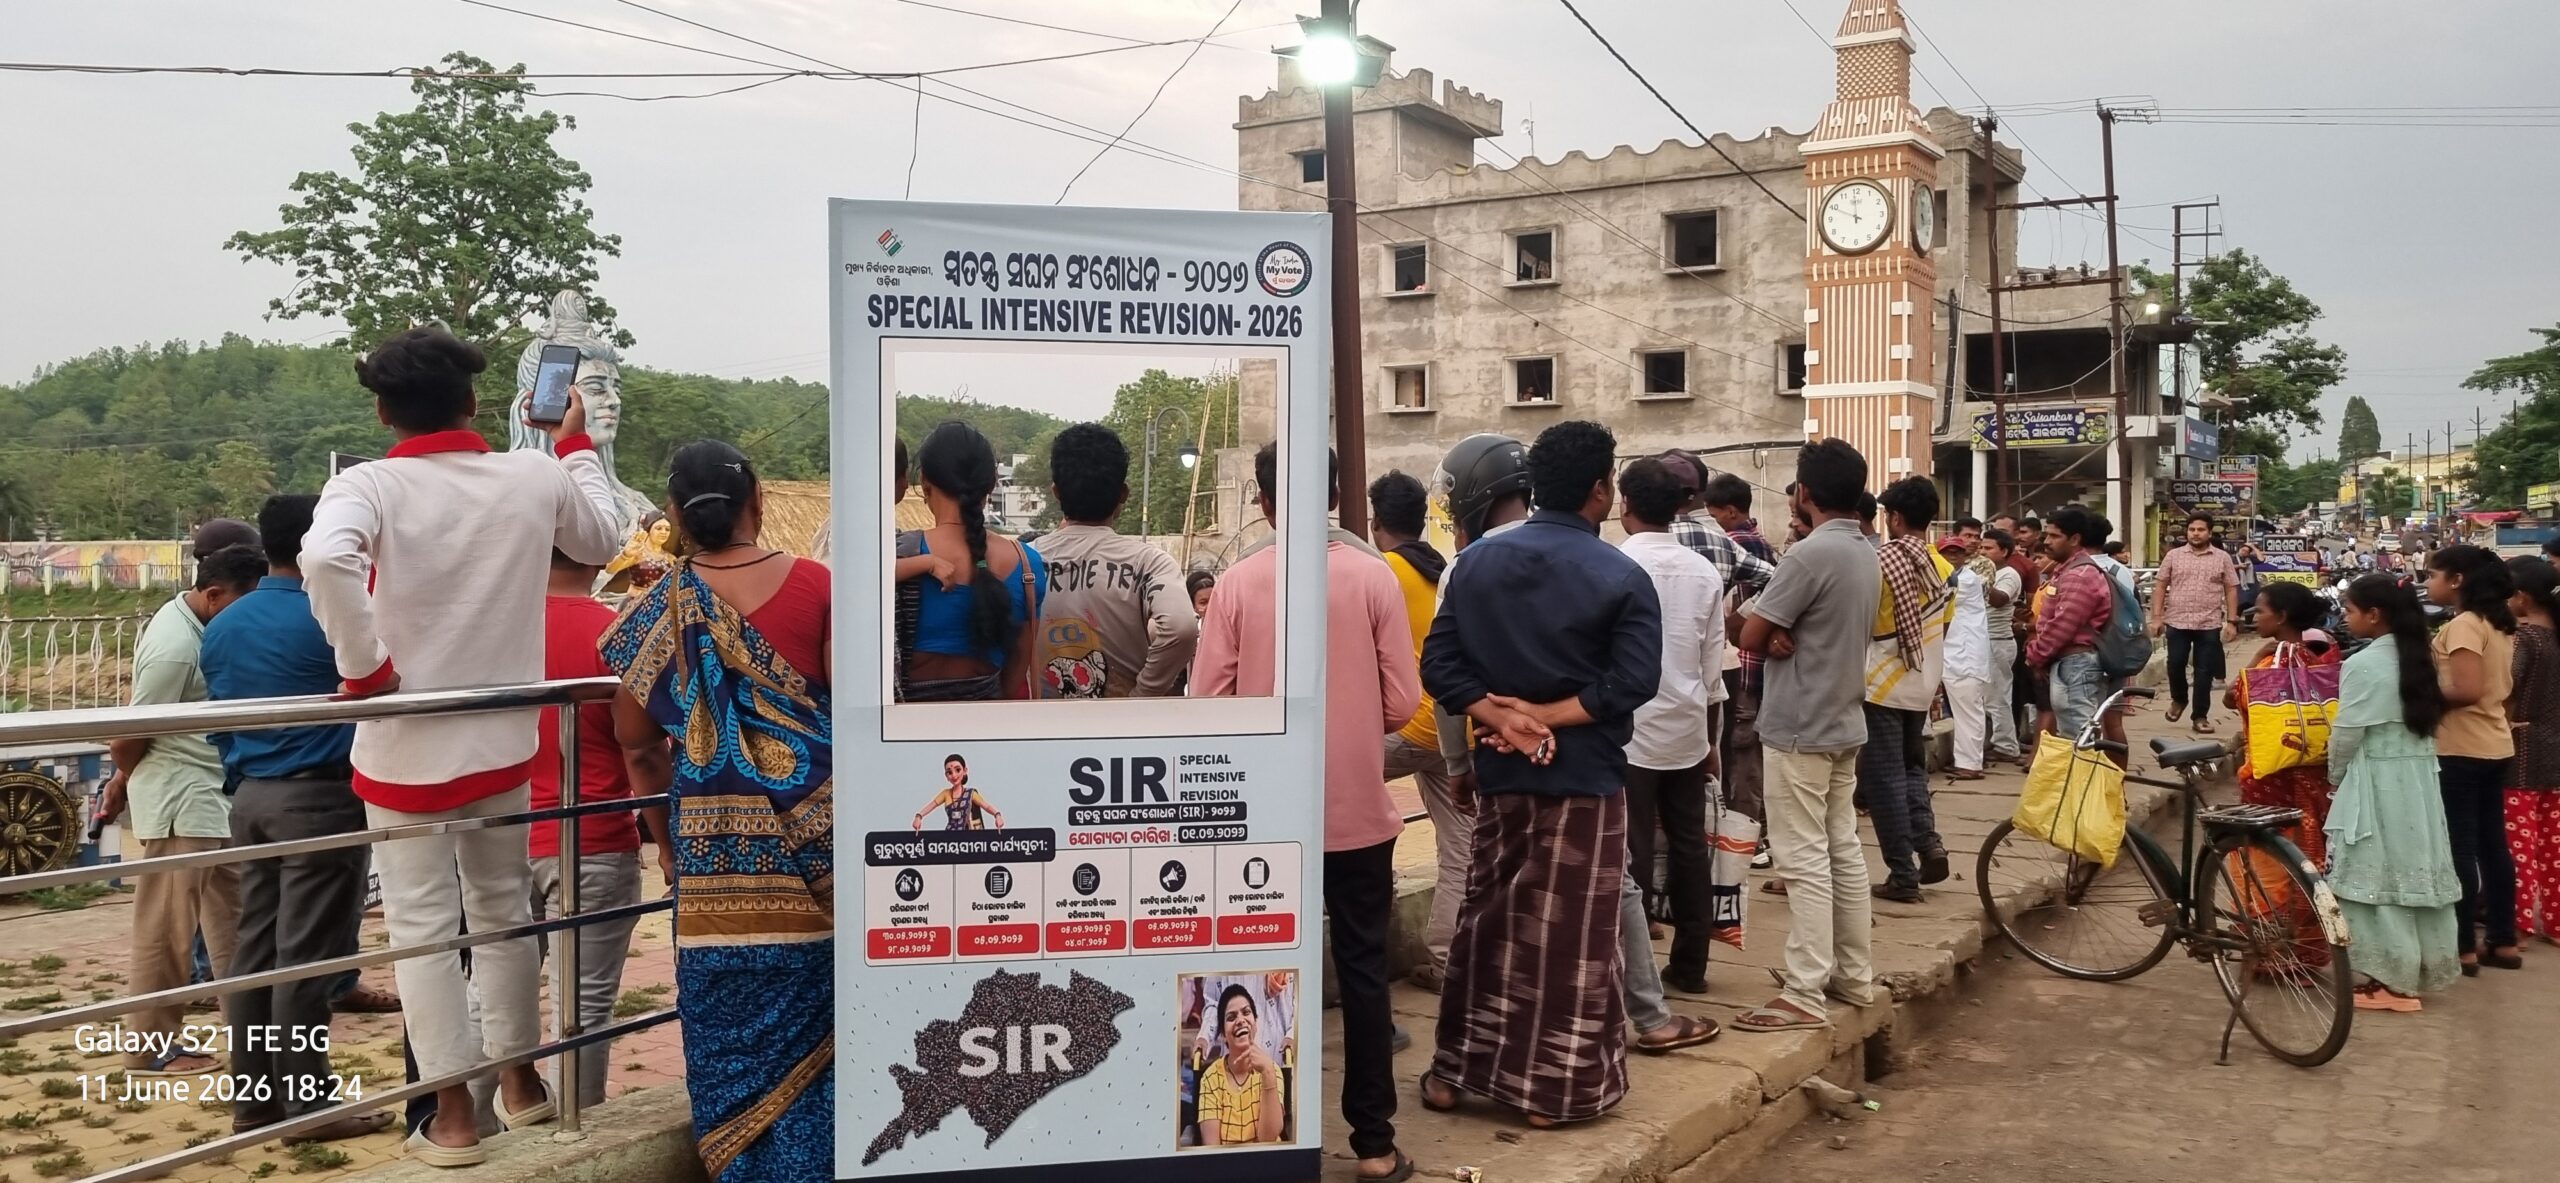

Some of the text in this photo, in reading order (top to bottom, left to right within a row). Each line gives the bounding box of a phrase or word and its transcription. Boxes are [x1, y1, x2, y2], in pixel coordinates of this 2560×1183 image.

[1006, 251, 1059, 290] ସଘନ
[1067, 255, 1161, 292] ସଂଶୋଧନ
[1266, 266, 1303, 275] My Vote
[868, 294, 1304, 338] SPECIAL INTENSIVE REVISION- 2026
[1069, 559, 1099, 593] DIE
[1179, 754, 1231, 766] SPECIAL
[1068, 756, 1170, 805] SIR
[1180, 771, 1246, 784] INTENSIVE
[1180, 788, 1239, 801] REVISION
[1130, 807, 1177, 819] ସଂଶୋଧନ
[1069, 829, 1127, 845] ଯୋଗ୍ୟତା
[928, 840, 987, 855] ସମୟସୀମା
[957, 1022, 1074, 1078] SIR
